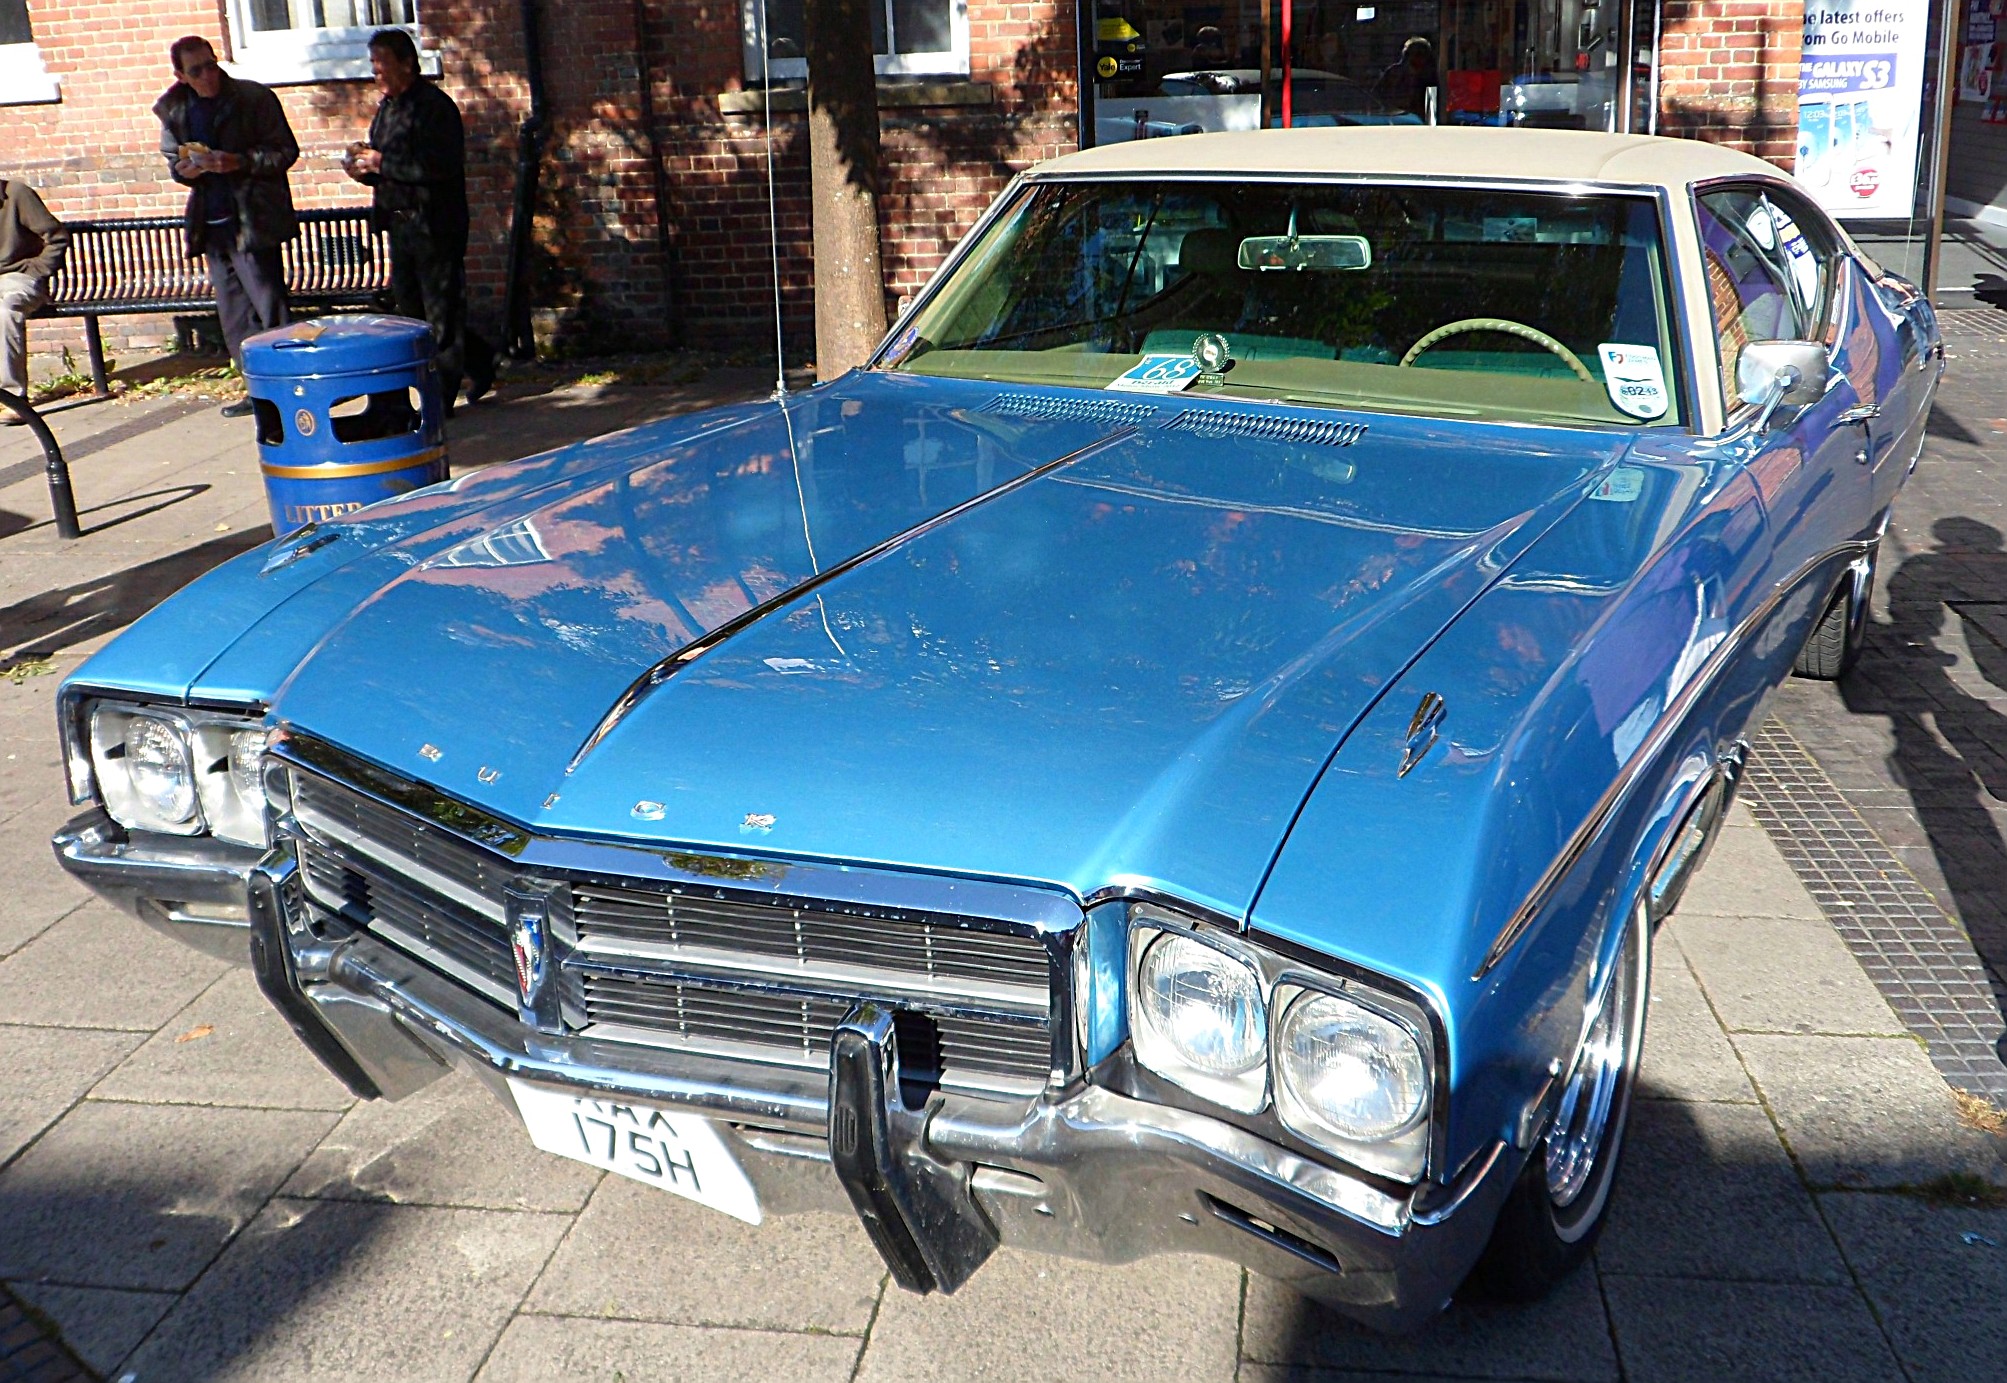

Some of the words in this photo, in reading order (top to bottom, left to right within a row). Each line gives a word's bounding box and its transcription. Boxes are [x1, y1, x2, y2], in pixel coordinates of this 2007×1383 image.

[1820, 9, 1860, 25] latest
[1864, 9, 1904, 24] offers
[1802, 34, 1826, 46] om
[1831, 30, 1848, 45] Go
[1852, 29, 1899, 44] Mobile
[1100, 62, 1116, 71] Yale
[1119, 63, 1141, 72] Expert
[1812, 61, 1864, 78] GALAXY
[1859, 59, 1891, 90] S3
[1808, 78, 1848, 90] SAMSUNG
[1143, 358, 1195, 380] 68
[571, 1111, 701, 1194] 175H
